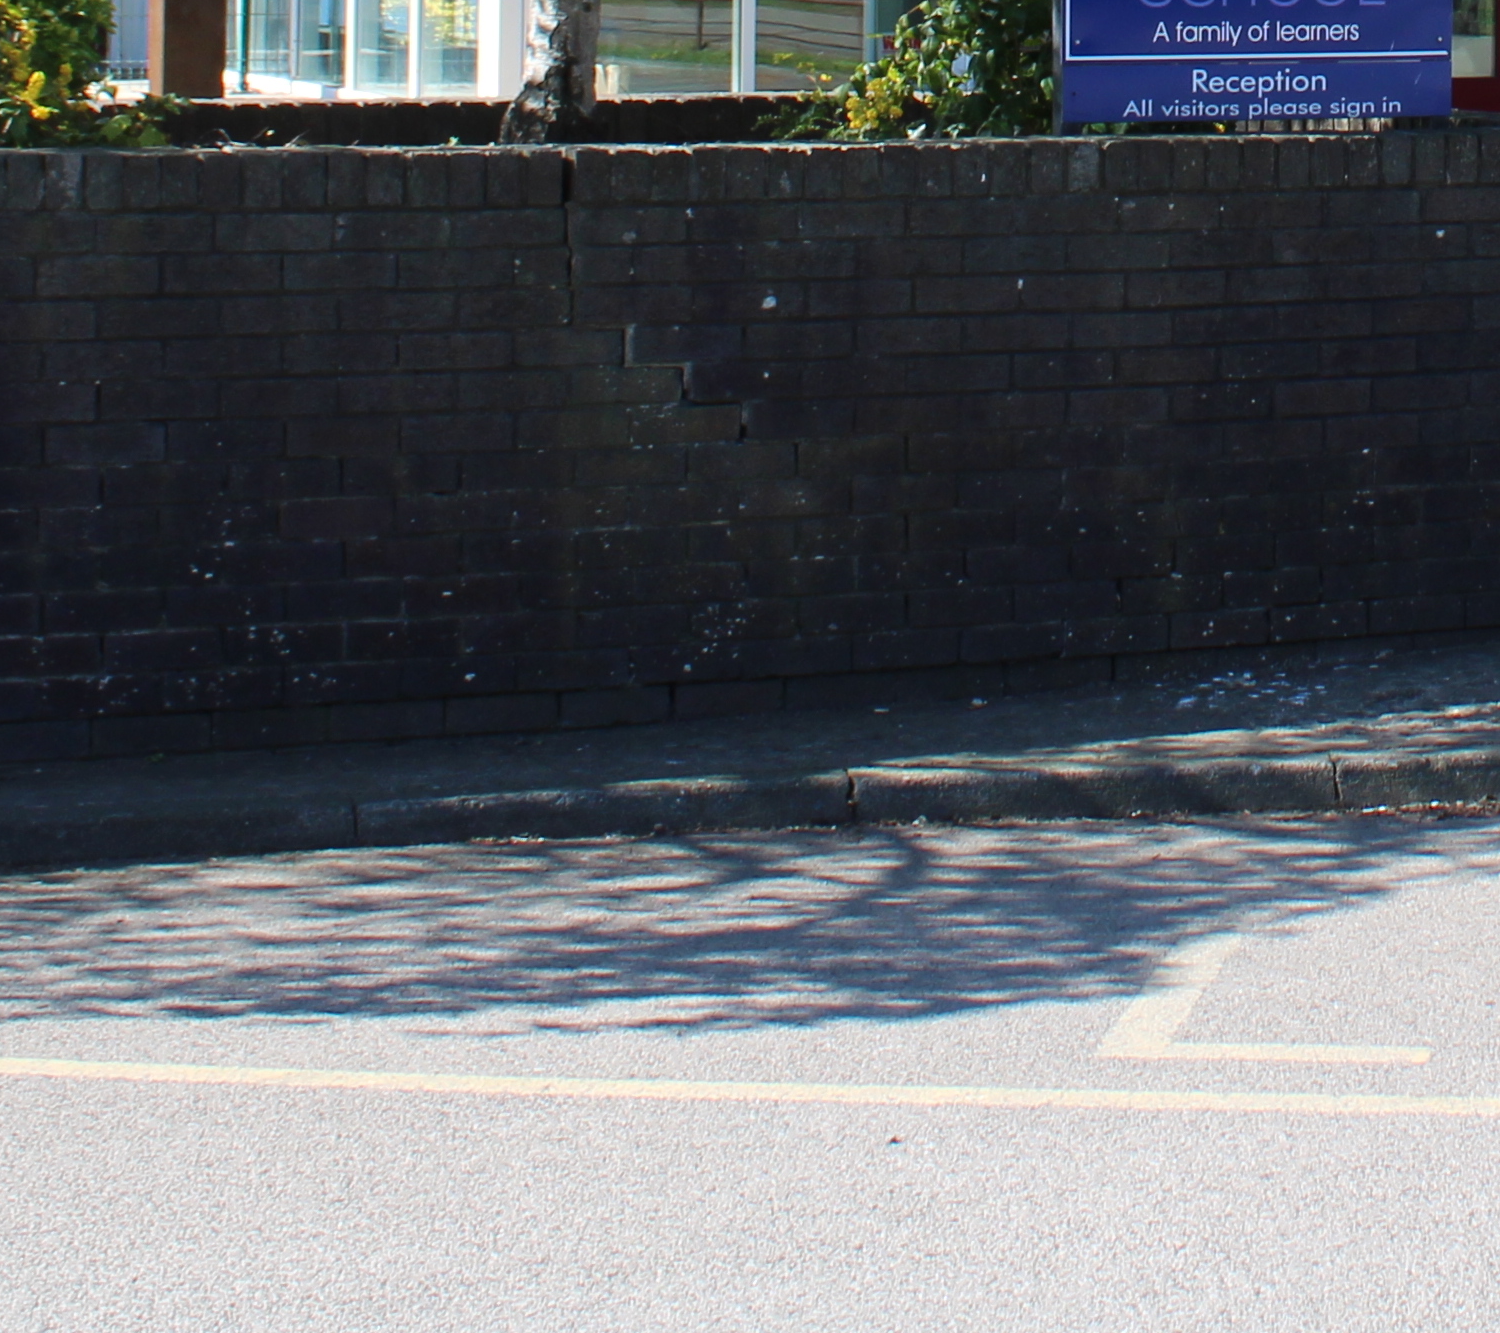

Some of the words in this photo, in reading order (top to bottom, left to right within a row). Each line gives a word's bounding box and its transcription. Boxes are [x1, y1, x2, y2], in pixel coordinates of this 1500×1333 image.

[1152, 21, 1170, 43] A
[1175, 20, 1242, 47] family
[1247, 19, 1270, 42] of
[1275, 21, 1360, 42] learners
[1191, 68, 1327, 99] Reception
[1122, 99, 1153, 118] All
[1161, 99, 1240, 117] visitors
[1248, 97, 1322, 119] please
[1329, 96, 1375, 118] sign
[1381, 95, 1402, 114] in
